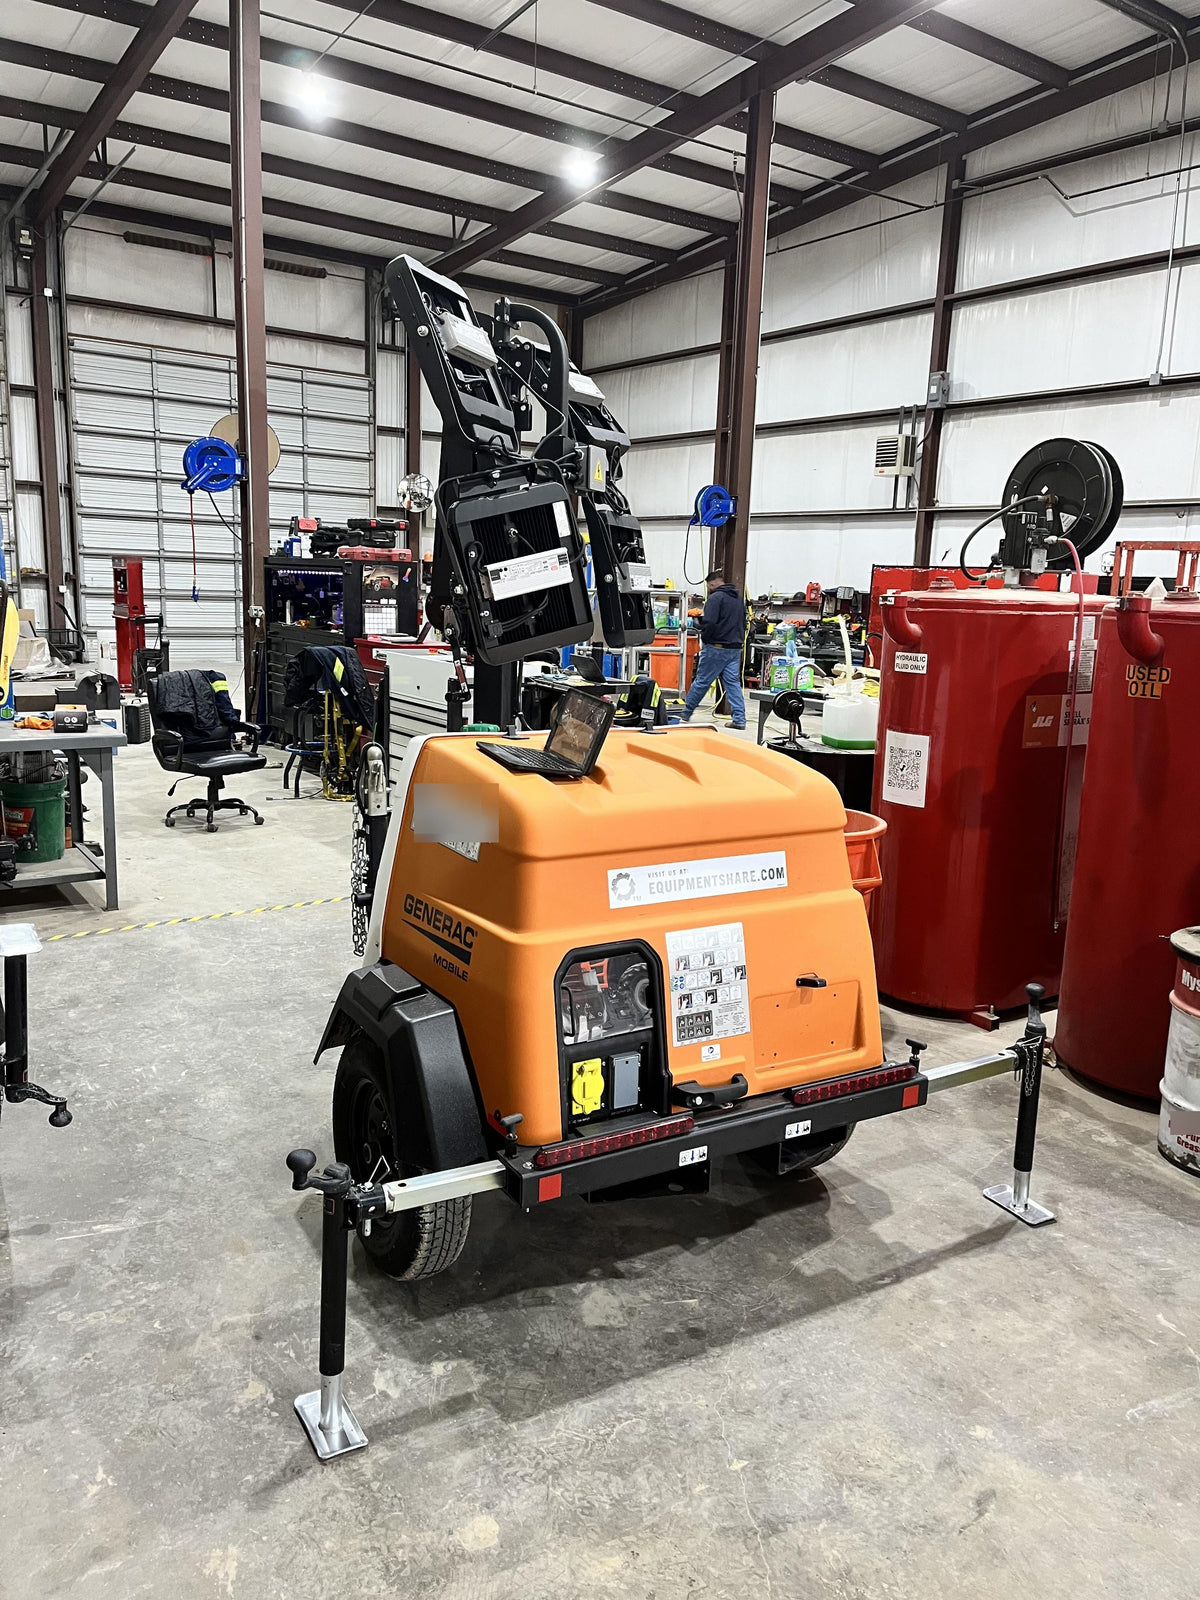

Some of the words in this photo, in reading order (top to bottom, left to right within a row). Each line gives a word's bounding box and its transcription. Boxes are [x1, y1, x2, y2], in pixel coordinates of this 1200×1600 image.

[896, 654, 926, 662] HYDRAULIC
[1127, 664, 1170, 682] USED
[1129, 682, 1161, 698] OIL
[1032, 715, 1054, 728] JLG
[647, 871, 665, 879] VISIT
[668, 869, 677, 877] US
[648, 866, 785, 895] EQUIPMENTSHARE.COM
[403, 893, 475, 950] GENERAC
[433, 952, 469, 982] MOBILE
